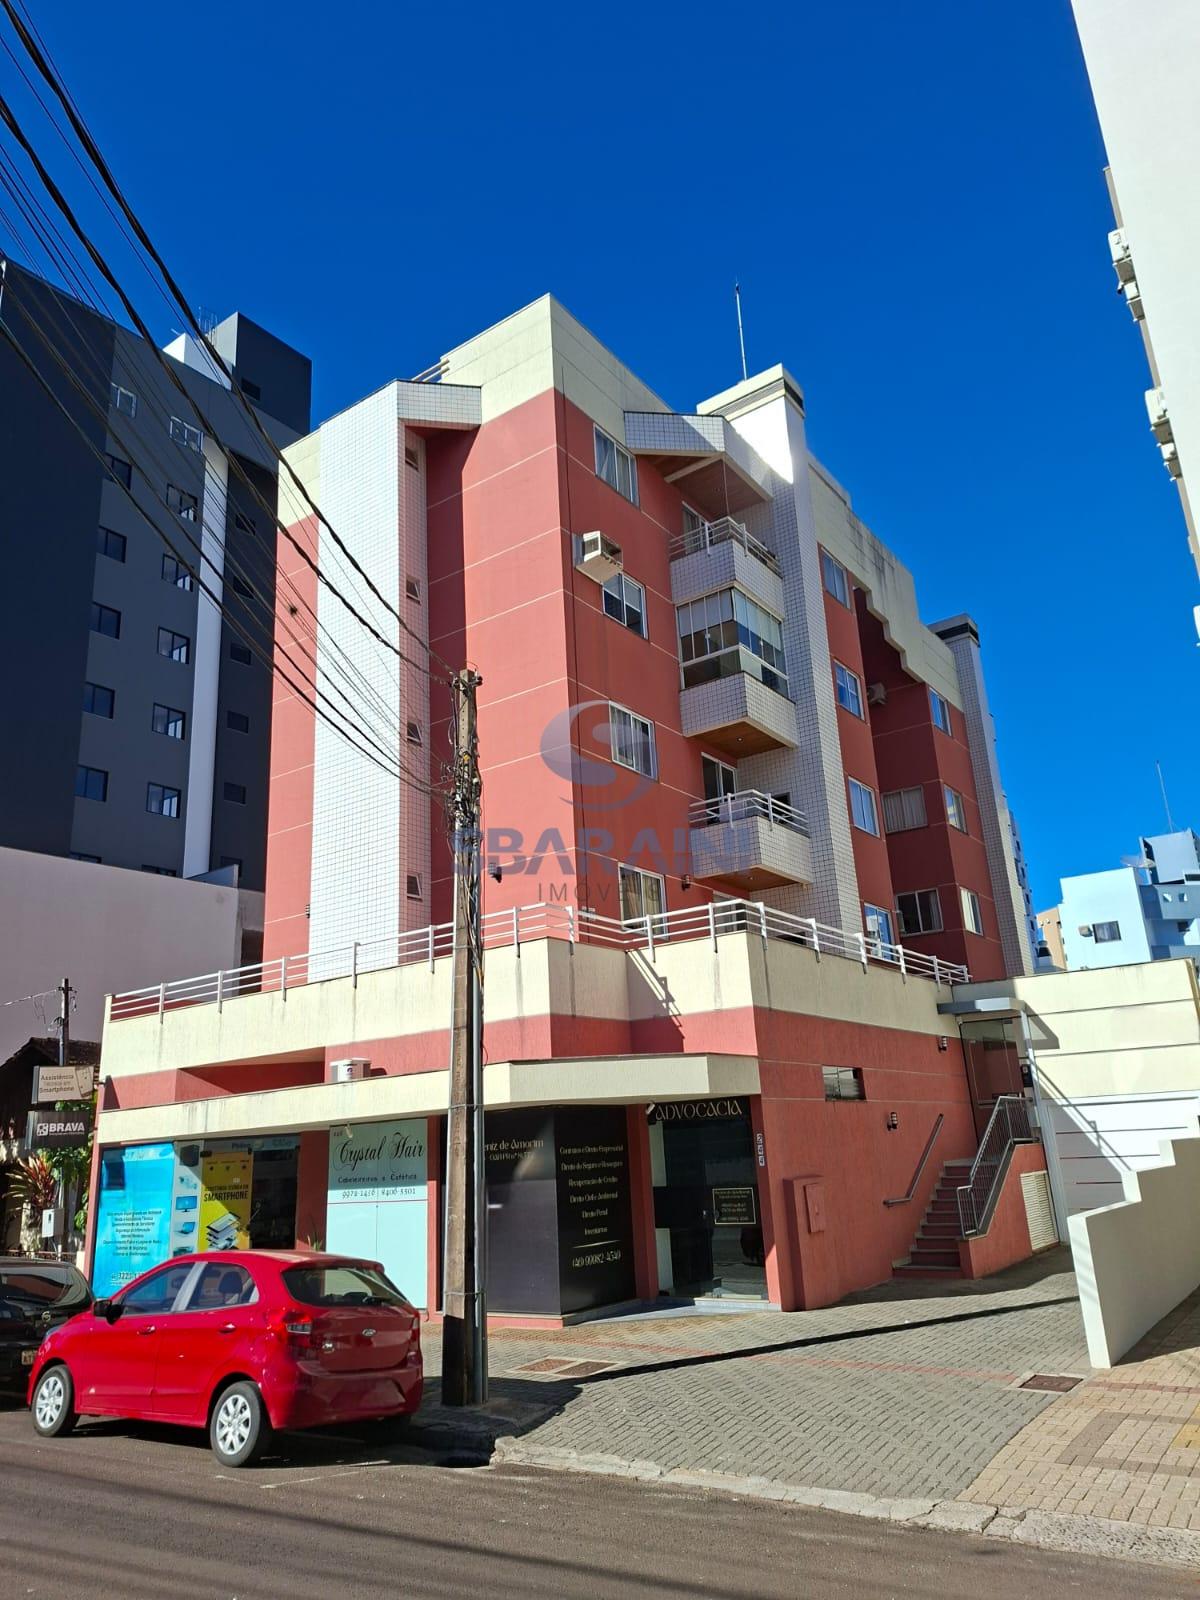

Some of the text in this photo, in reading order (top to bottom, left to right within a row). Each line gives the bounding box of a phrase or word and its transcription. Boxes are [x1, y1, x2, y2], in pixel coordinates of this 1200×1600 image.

[655, 1099, 743, 1120] ADVOCACIA
[49, 1122, 85, 1132] BRAVA
[333, 1135, 387, 1172] Crystal
[204, 1191, 249, 1201] SMARTPHONE
